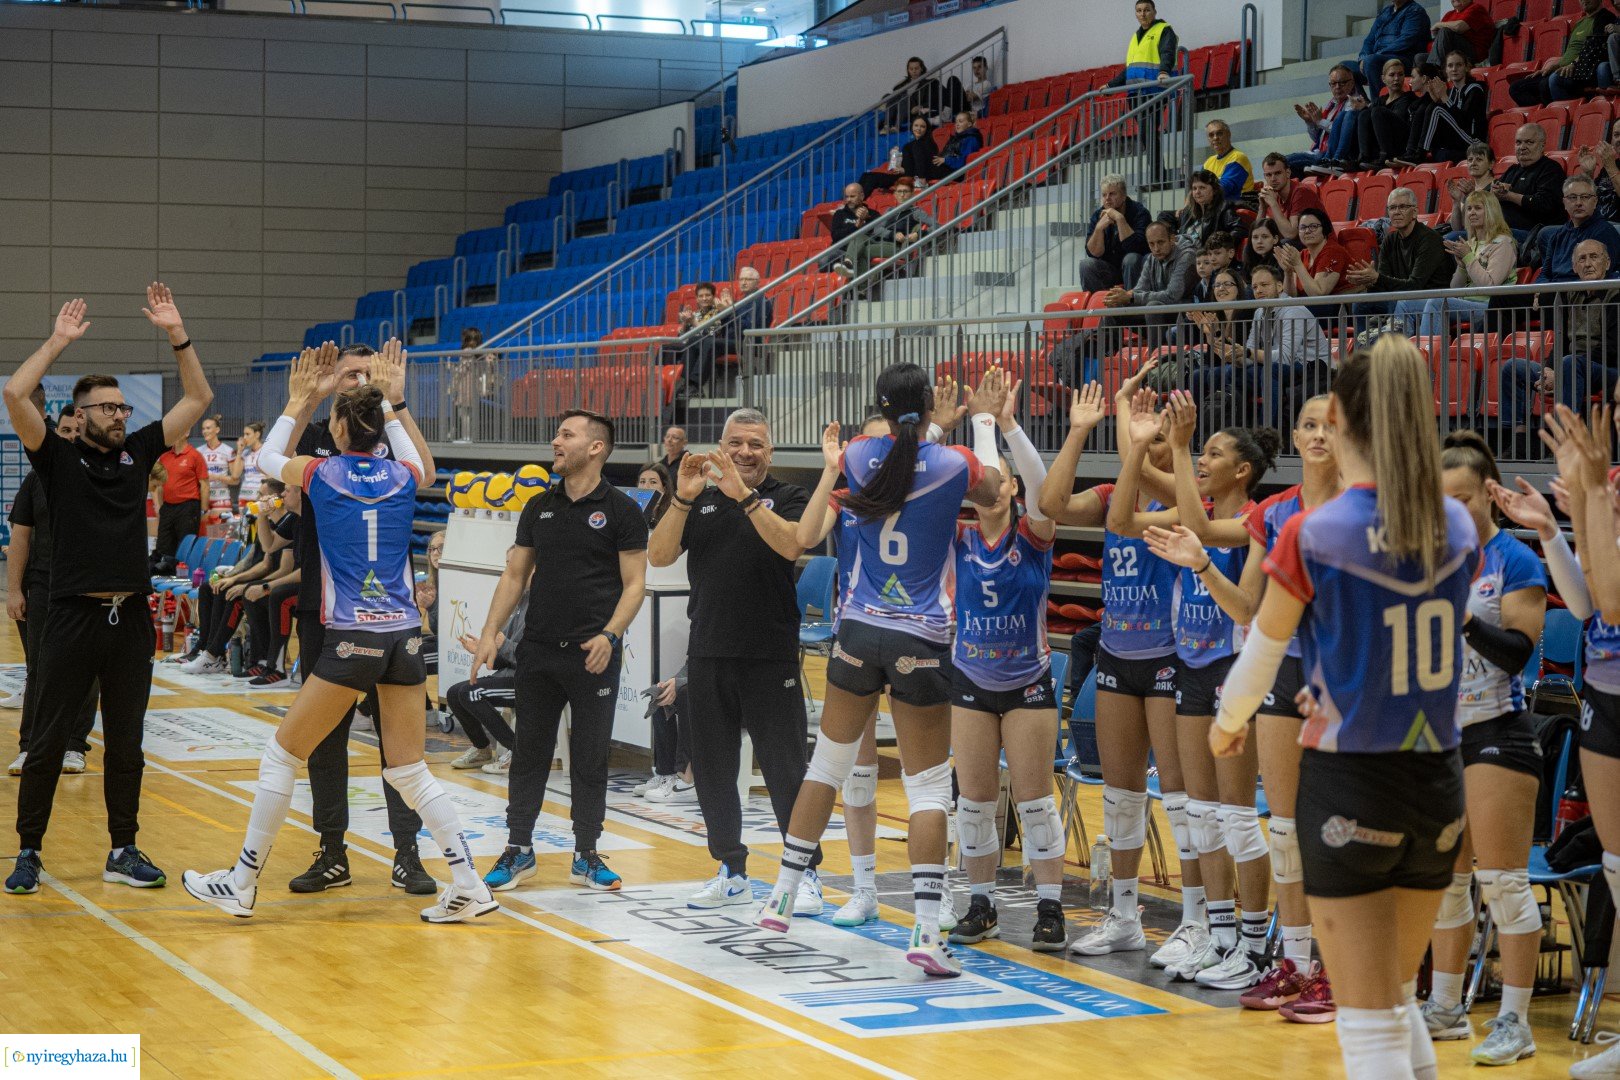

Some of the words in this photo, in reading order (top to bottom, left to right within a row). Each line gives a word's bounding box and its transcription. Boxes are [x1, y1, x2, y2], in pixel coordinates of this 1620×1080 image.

[362, 509, 378, 562] 1
[879, 511, 909, 566] 6
[1109, 545, 1139, 577] 22
[981, 580, 998, 608] 5
[1103, 579, 1160, 602] FATUM
[964, 609, 1027, 631] FATUM
[1382, 598, 1455, 697] 10
